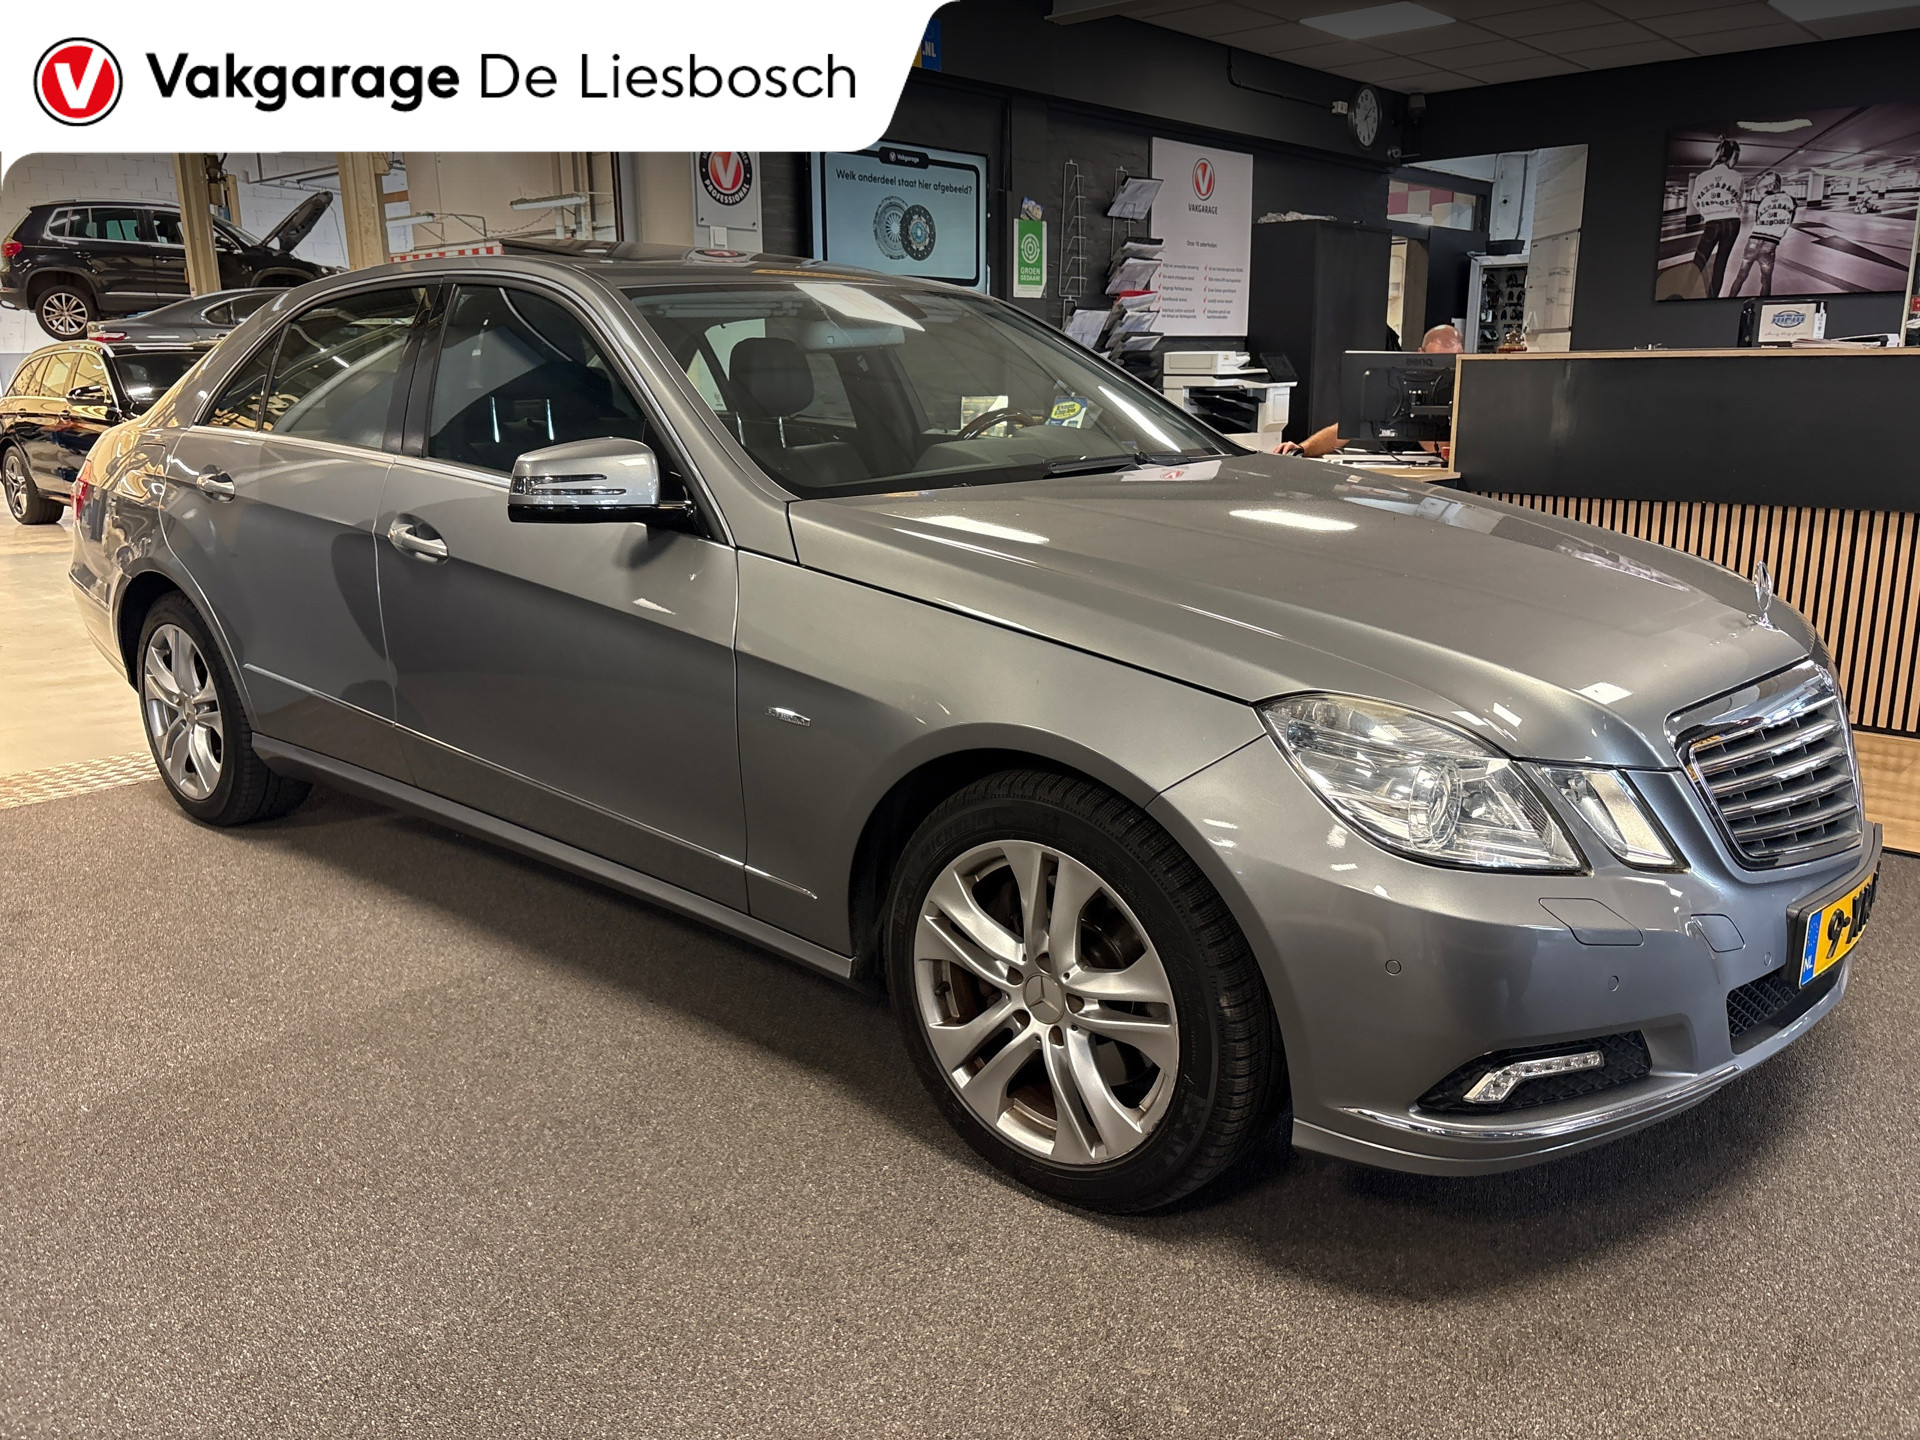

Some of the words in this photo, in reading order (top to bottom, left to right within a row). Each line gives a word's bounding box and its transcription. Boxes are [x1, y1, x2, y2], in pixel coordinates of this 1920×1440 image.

[836, 168, 856, 181] Welk
[858, 173, 897, 186] onderdeel
[898, 178, 917, 188] staat
[918, 180, 932, 190] hier
[933, 183, 973, 195] afgebeeld?
[704, 179, 750, 204] PROFESSIONAL
[1188, 203, 1218, 216] VAKGARAGE
[1020, 266, 1041, 275] GROEN
[1803, 954, 1813, 973] NL
